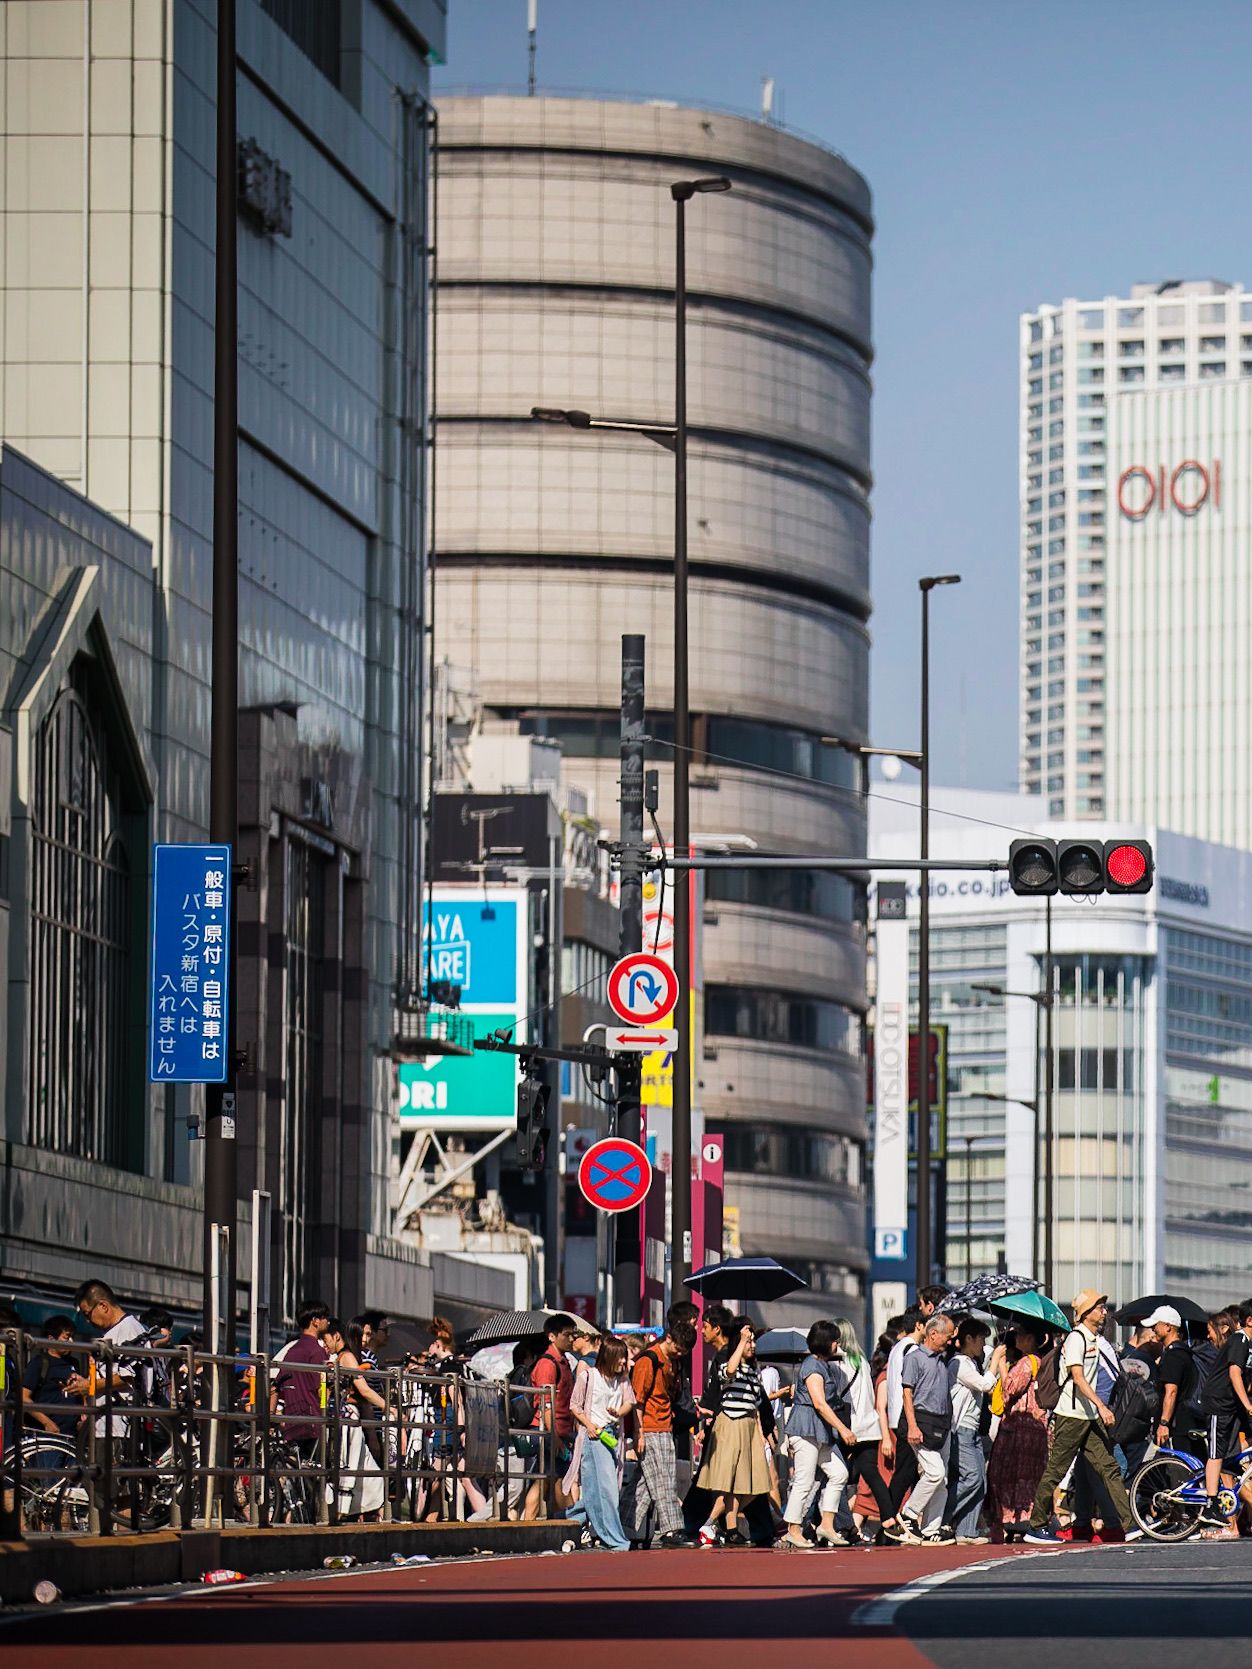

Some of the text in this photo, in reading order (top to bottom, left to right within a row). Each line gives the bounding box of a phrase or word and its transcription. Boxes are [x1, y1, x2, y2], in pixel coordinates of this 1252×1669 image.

[180, 894, 200, 1034] バスタ新宿へは
[202, 856, 224, 1059] 一般車・原付・自転車は
[157, 974, 177, 1074] 入れません
[882, 1232, 898, 1251] P
